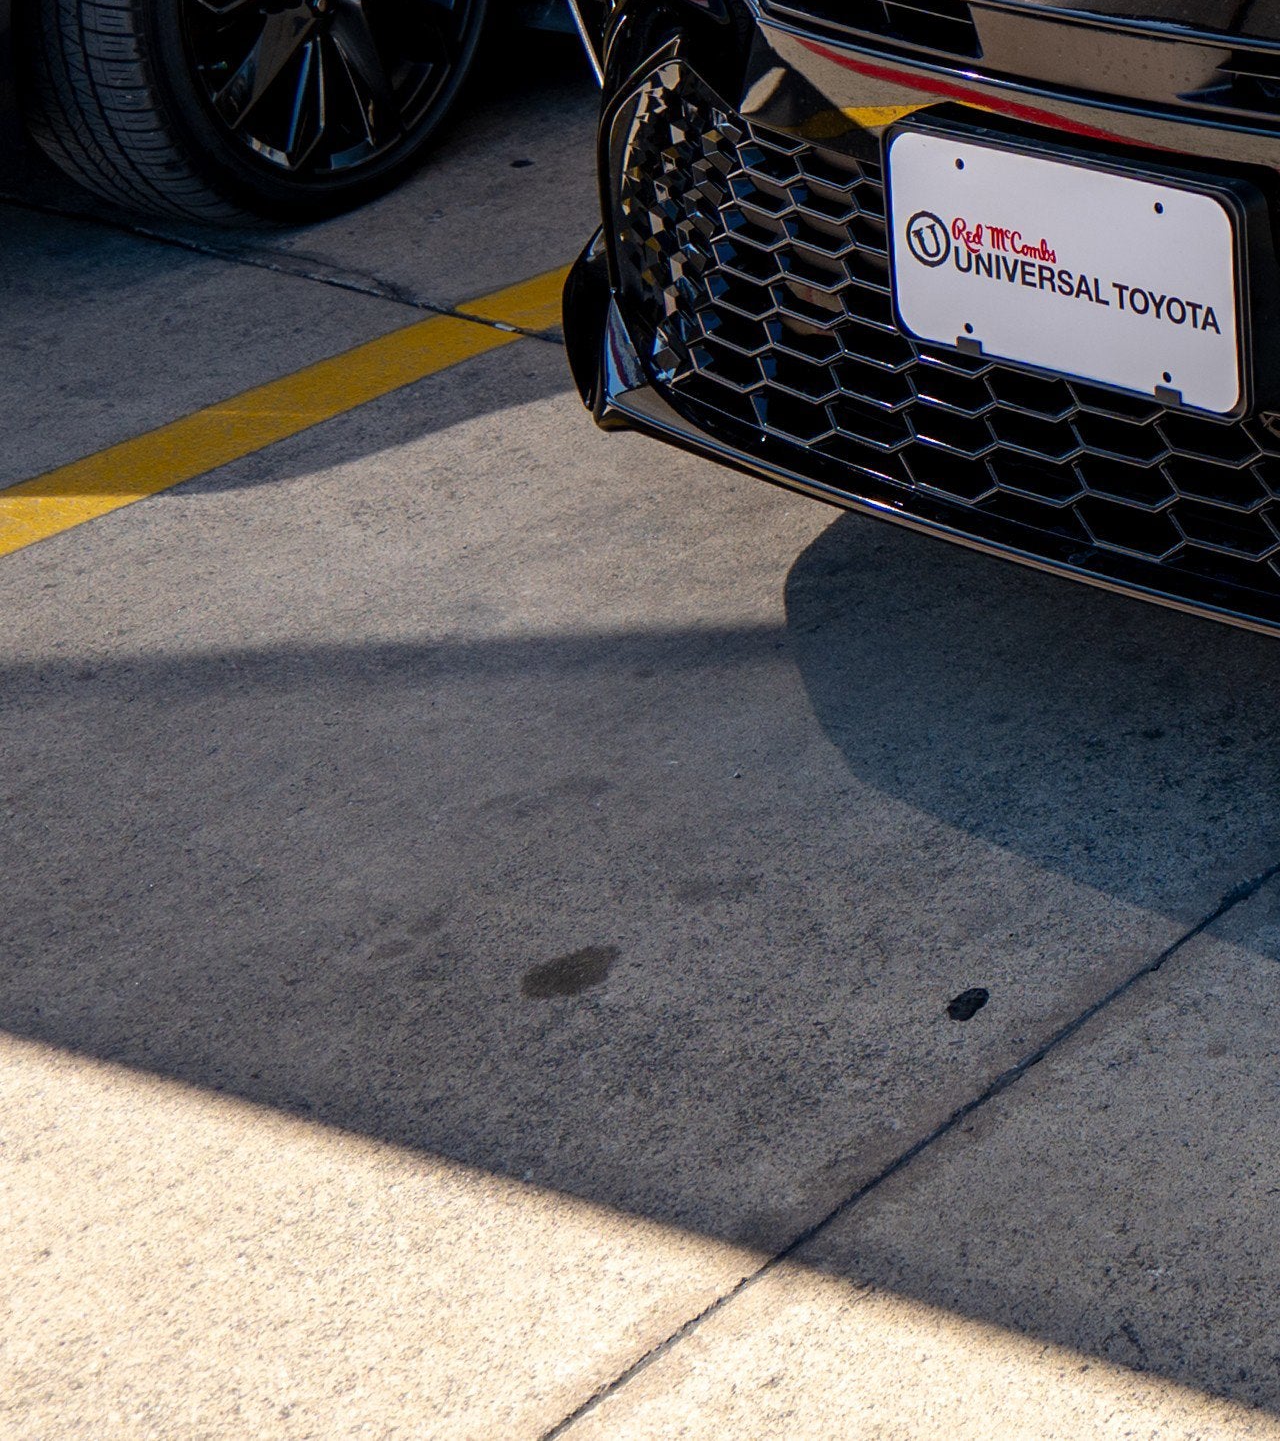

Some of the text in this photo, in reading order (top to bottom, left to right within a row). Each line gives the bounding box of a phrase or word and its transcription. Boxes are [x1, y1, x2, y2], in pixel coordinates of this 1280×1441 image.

[951, 217, 1057, 264] Red McCombs
[953, 245, 1222, 335] UNIVERSAL TOYOTA
